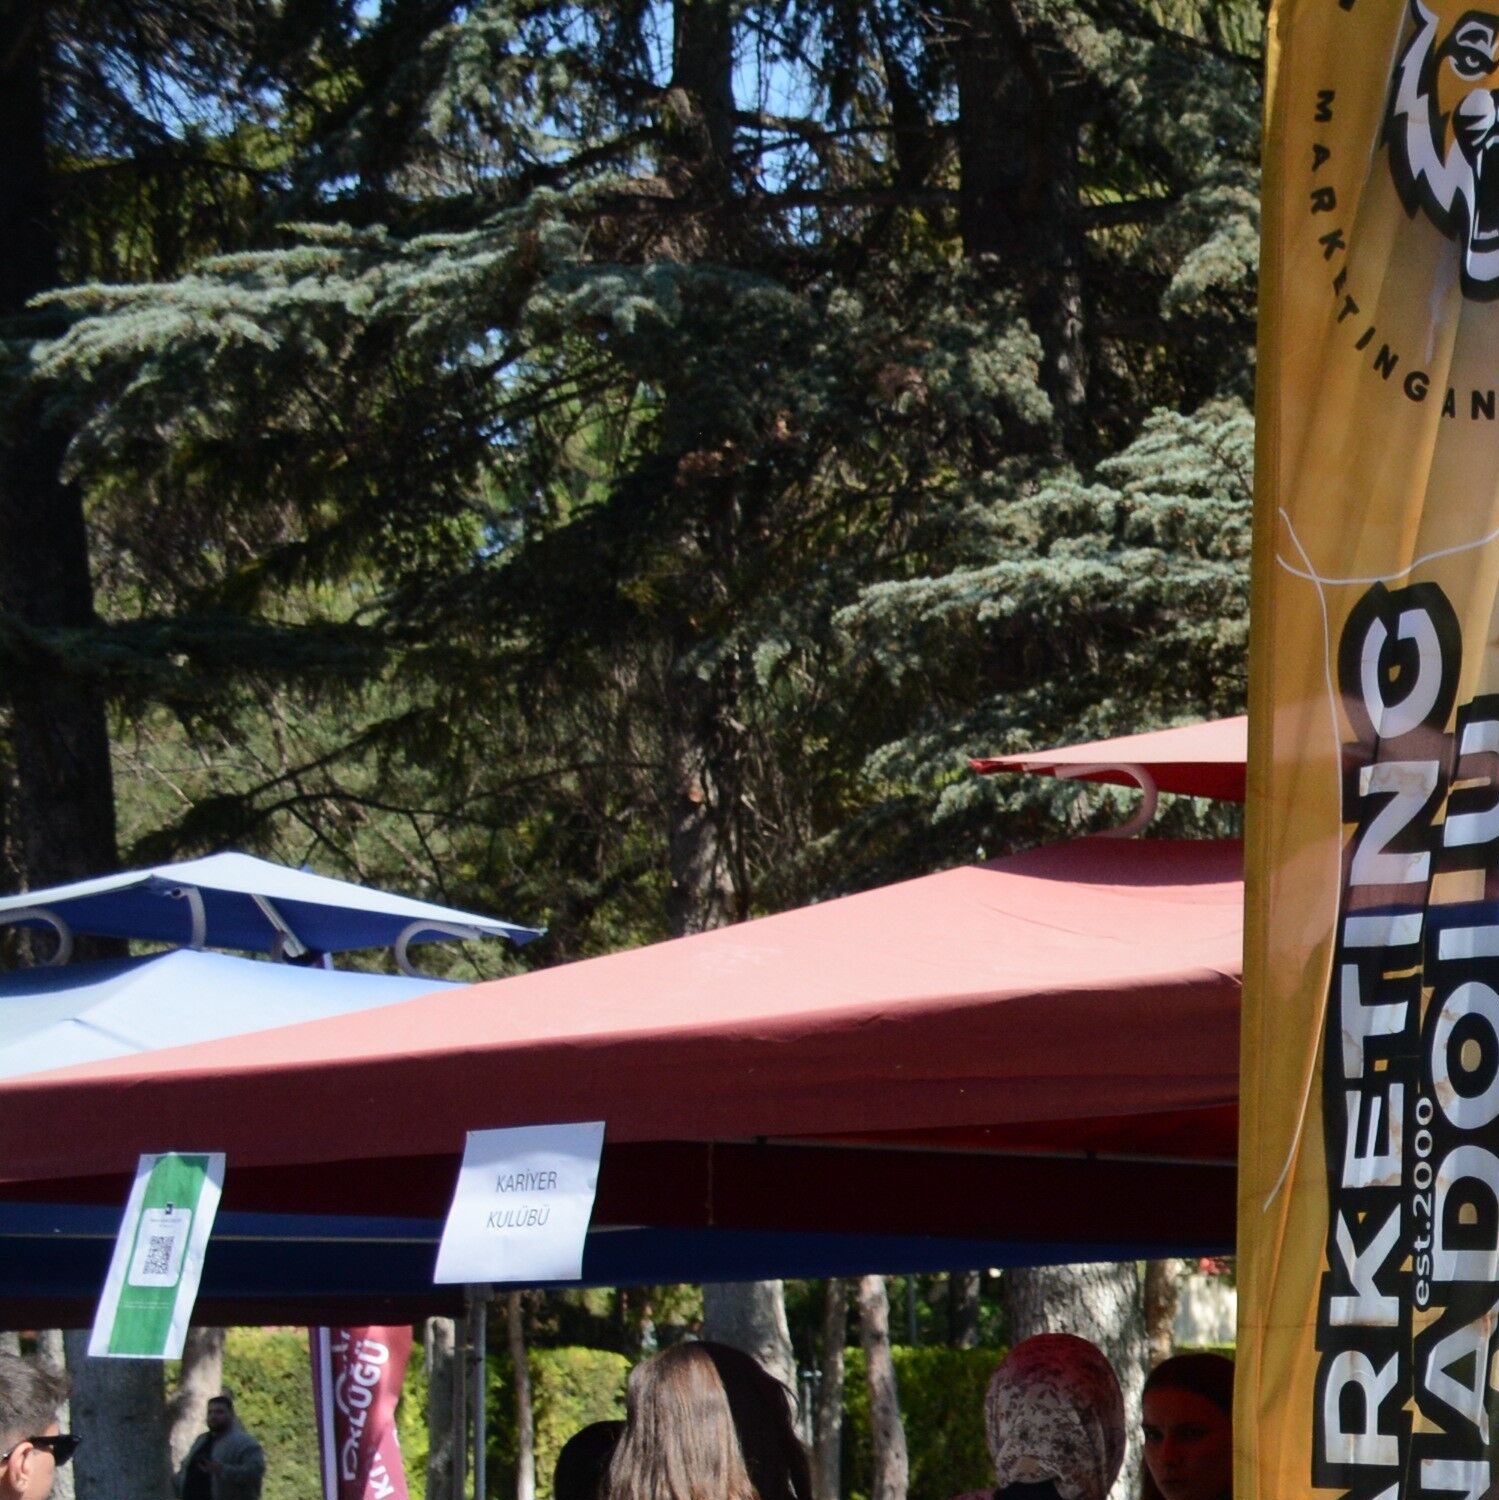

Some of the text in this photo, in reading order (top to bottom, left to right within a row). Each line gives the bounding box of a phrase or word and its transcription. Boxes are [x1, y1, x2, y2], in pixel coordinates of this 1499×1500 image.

[495, 1167, 558, 1194] KARİYER
[1414, 1096, 1435, 1307] est.2000
[486, 1203, 551, 1229] KULÜBÜ
